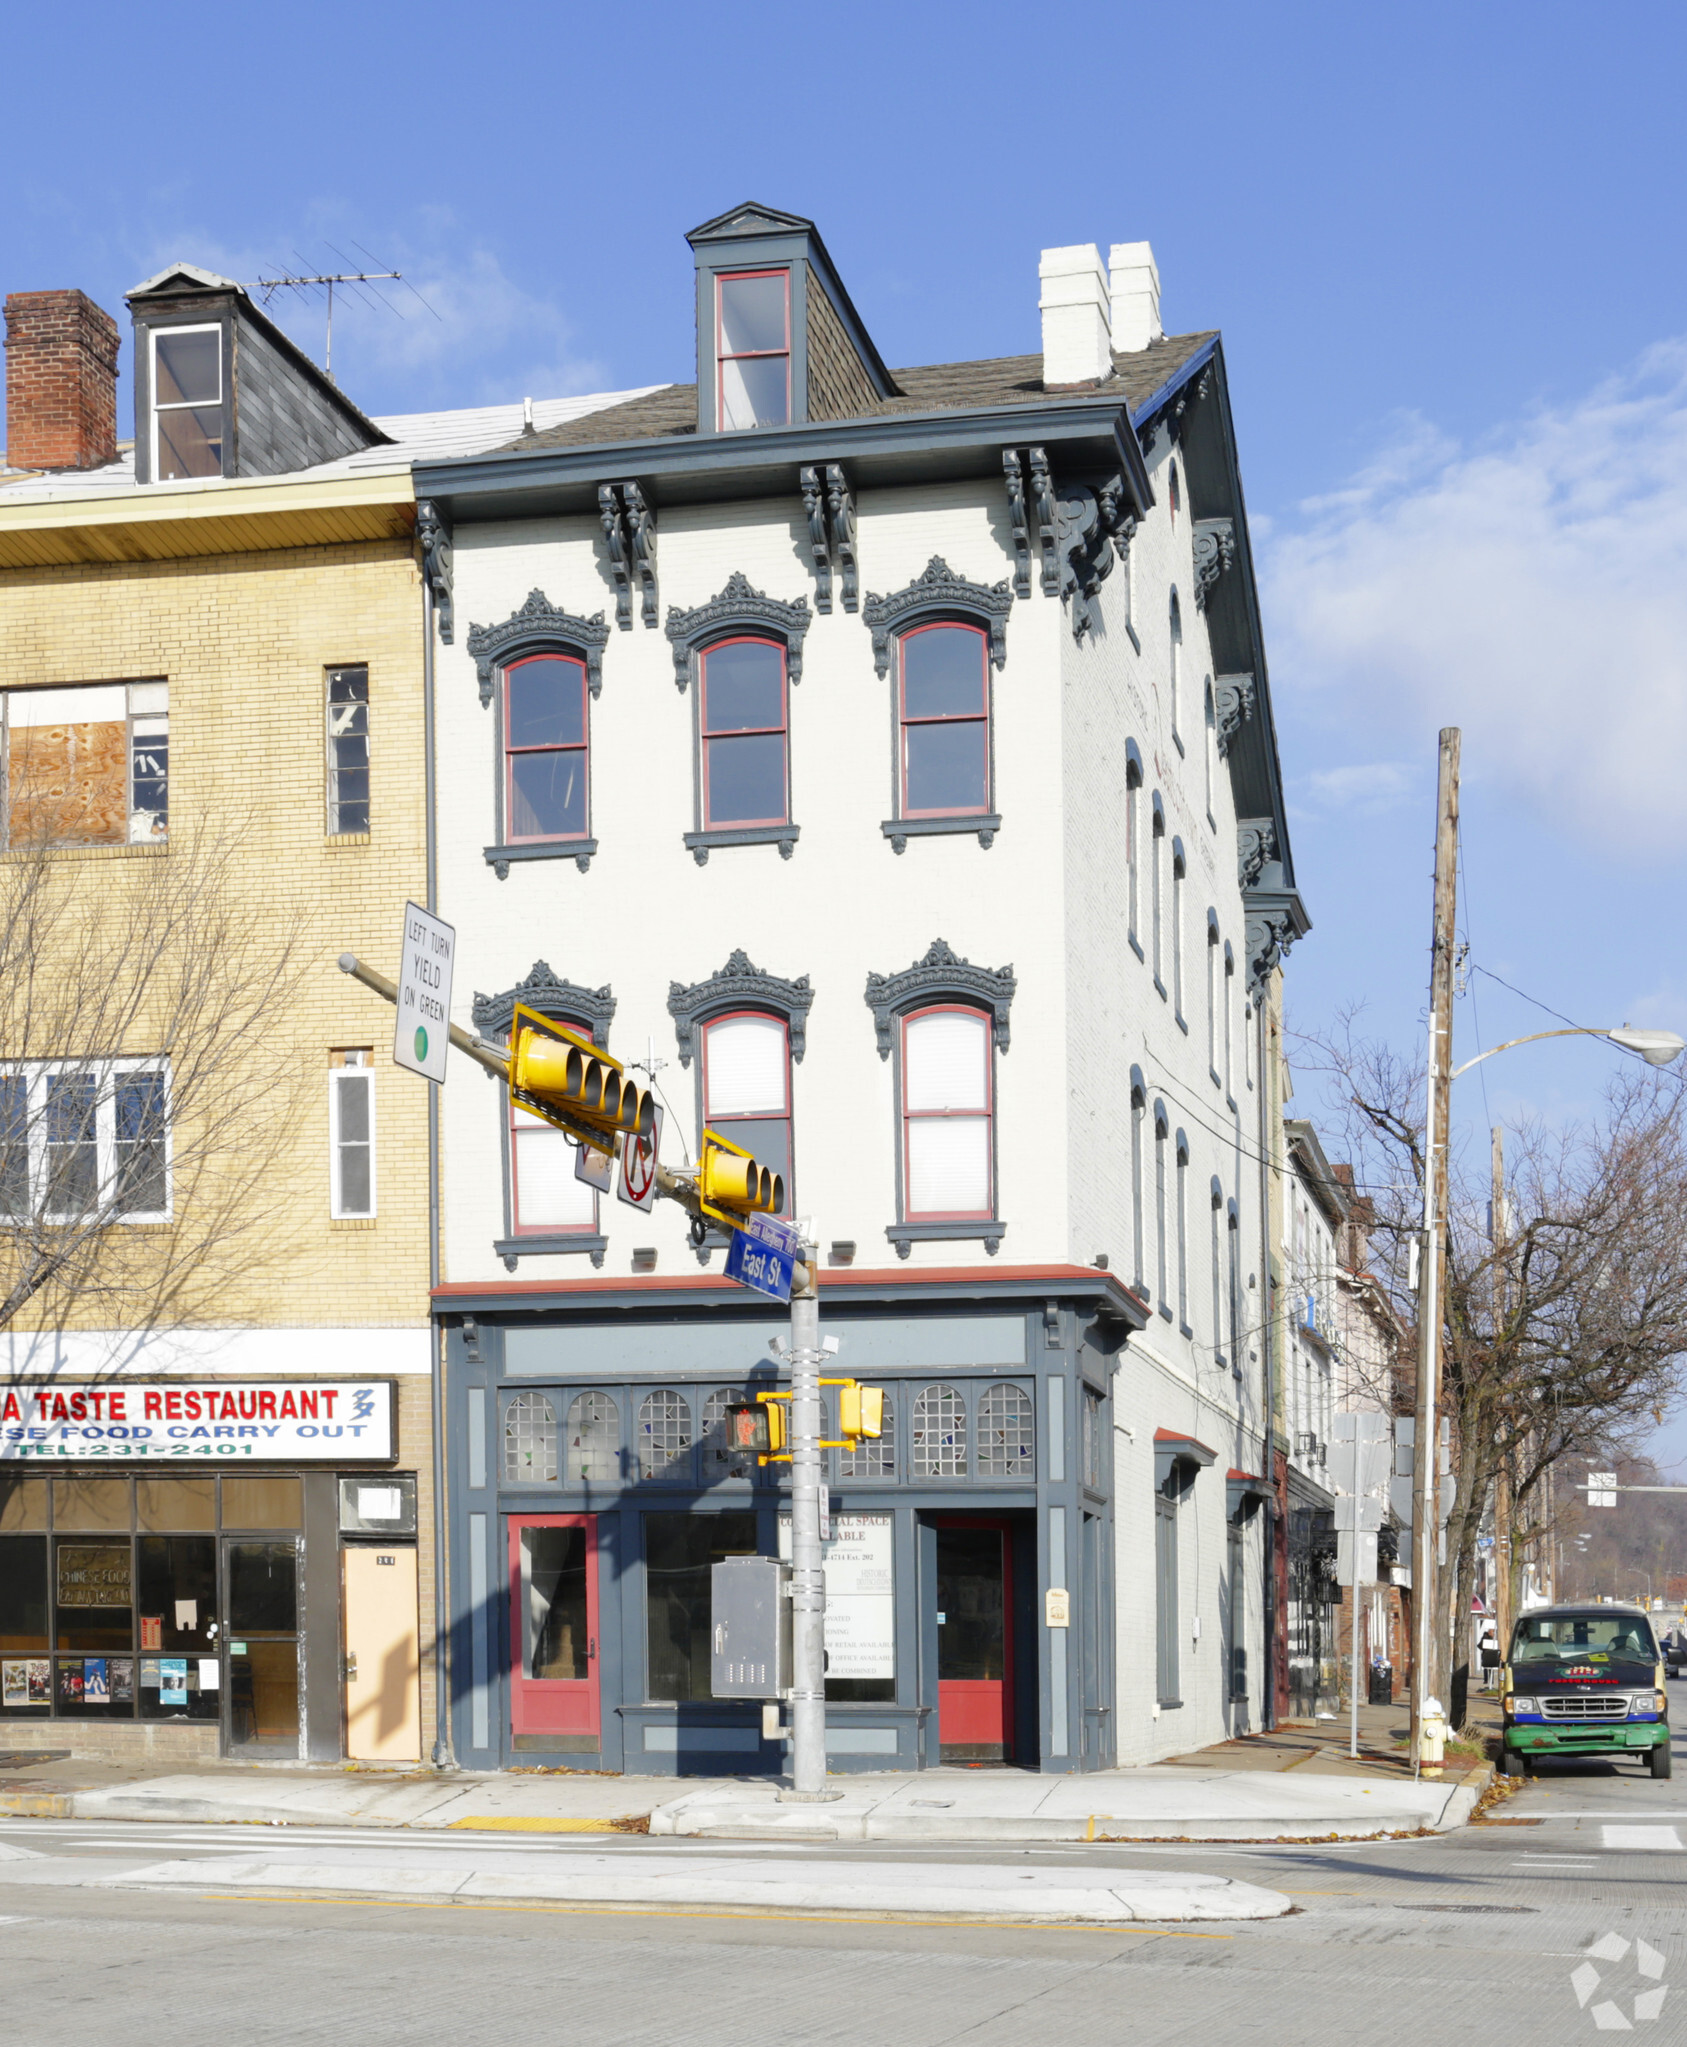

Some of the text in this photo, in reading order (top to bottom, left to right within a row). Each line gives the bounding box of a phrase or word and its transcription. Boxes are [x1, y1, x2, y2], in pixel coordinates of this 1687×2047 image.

[409, 919, 450, 960] LEFT TURN
[414, 953, 441, 990] YIELD
[405, 986, 444, 1023] ON GREEN
[741, 1243, 782, 1287] East St
[34, 1391, 127, 1421] TASTE
[144, 1390, 338, 1421] RESTAURANT
[61, 1426, 153, 1440] FOOD
[167, 1425, 281, 1438] CARRY
[296, 1424, 368, 1438] OUT
[855, 1515, 889, 1526] SPACE
